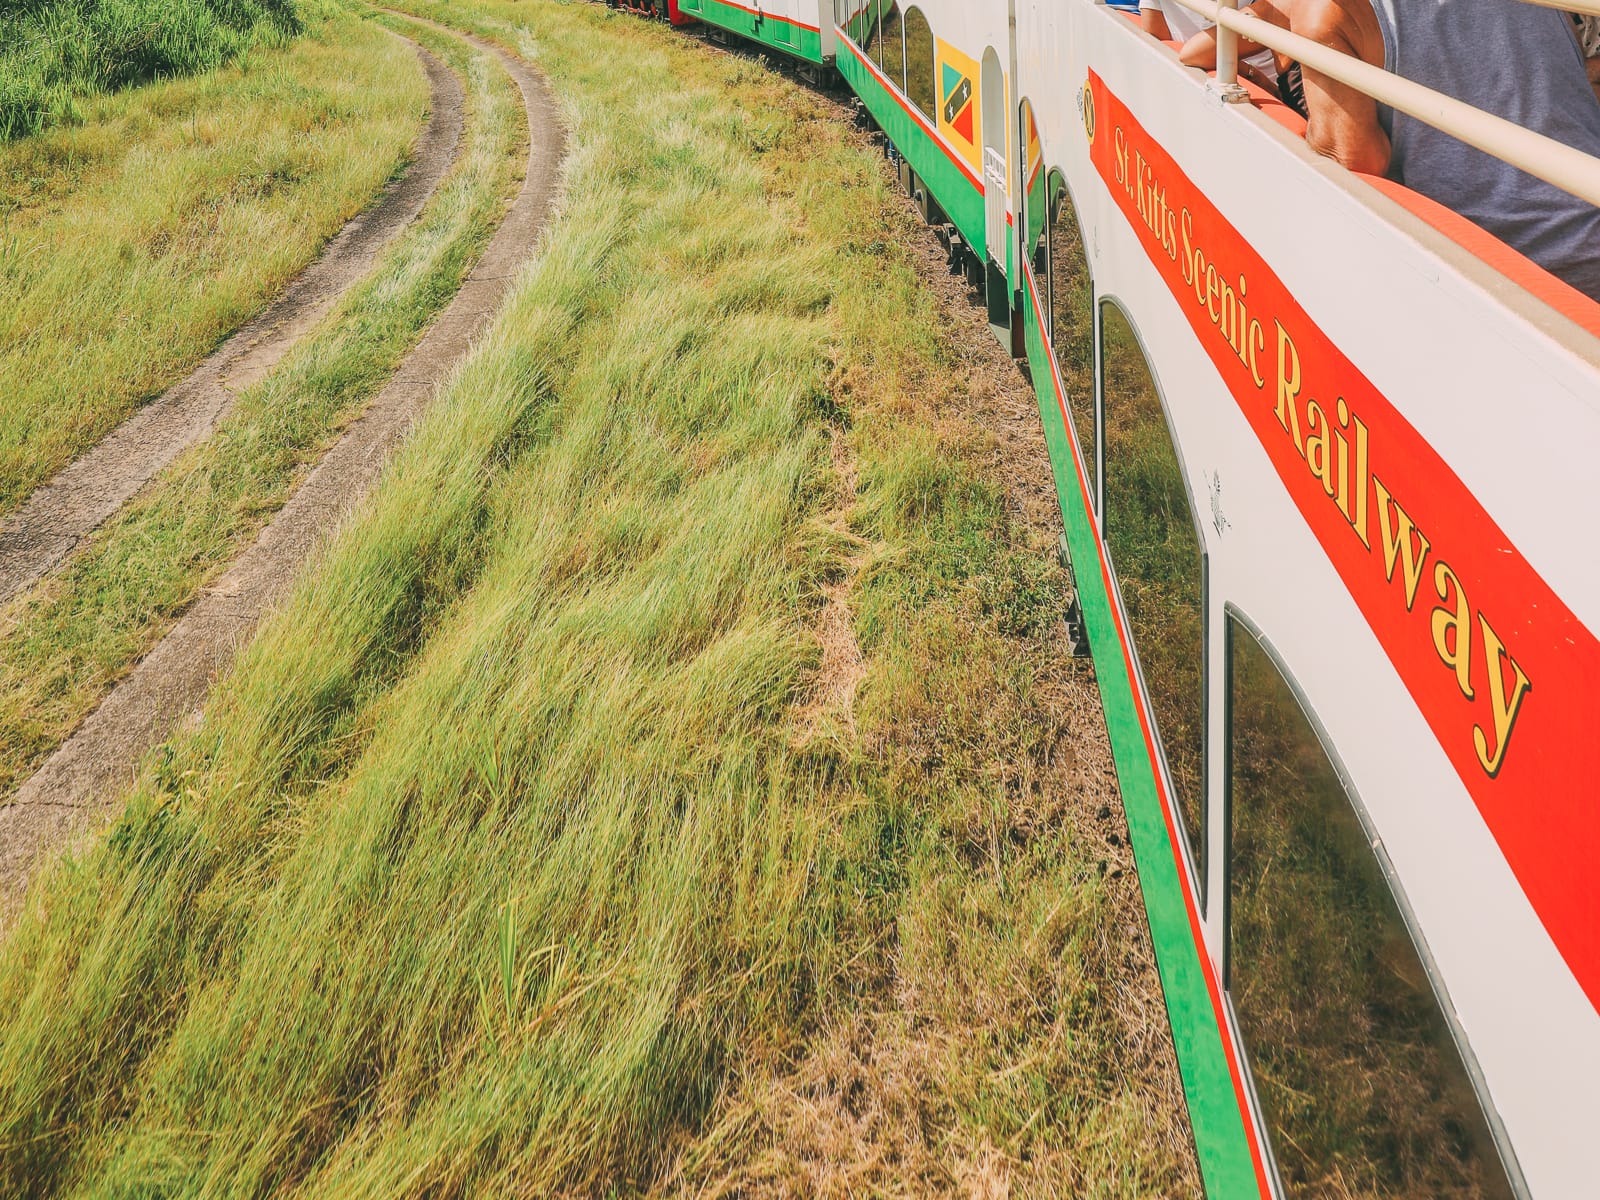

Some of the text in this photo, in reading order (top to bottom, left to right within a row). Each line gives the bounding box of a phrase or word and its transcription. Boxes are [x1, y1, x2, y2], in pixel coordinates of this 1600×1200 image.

[1115, 126, 1532, 779] St. Kitts Scenic Railway
